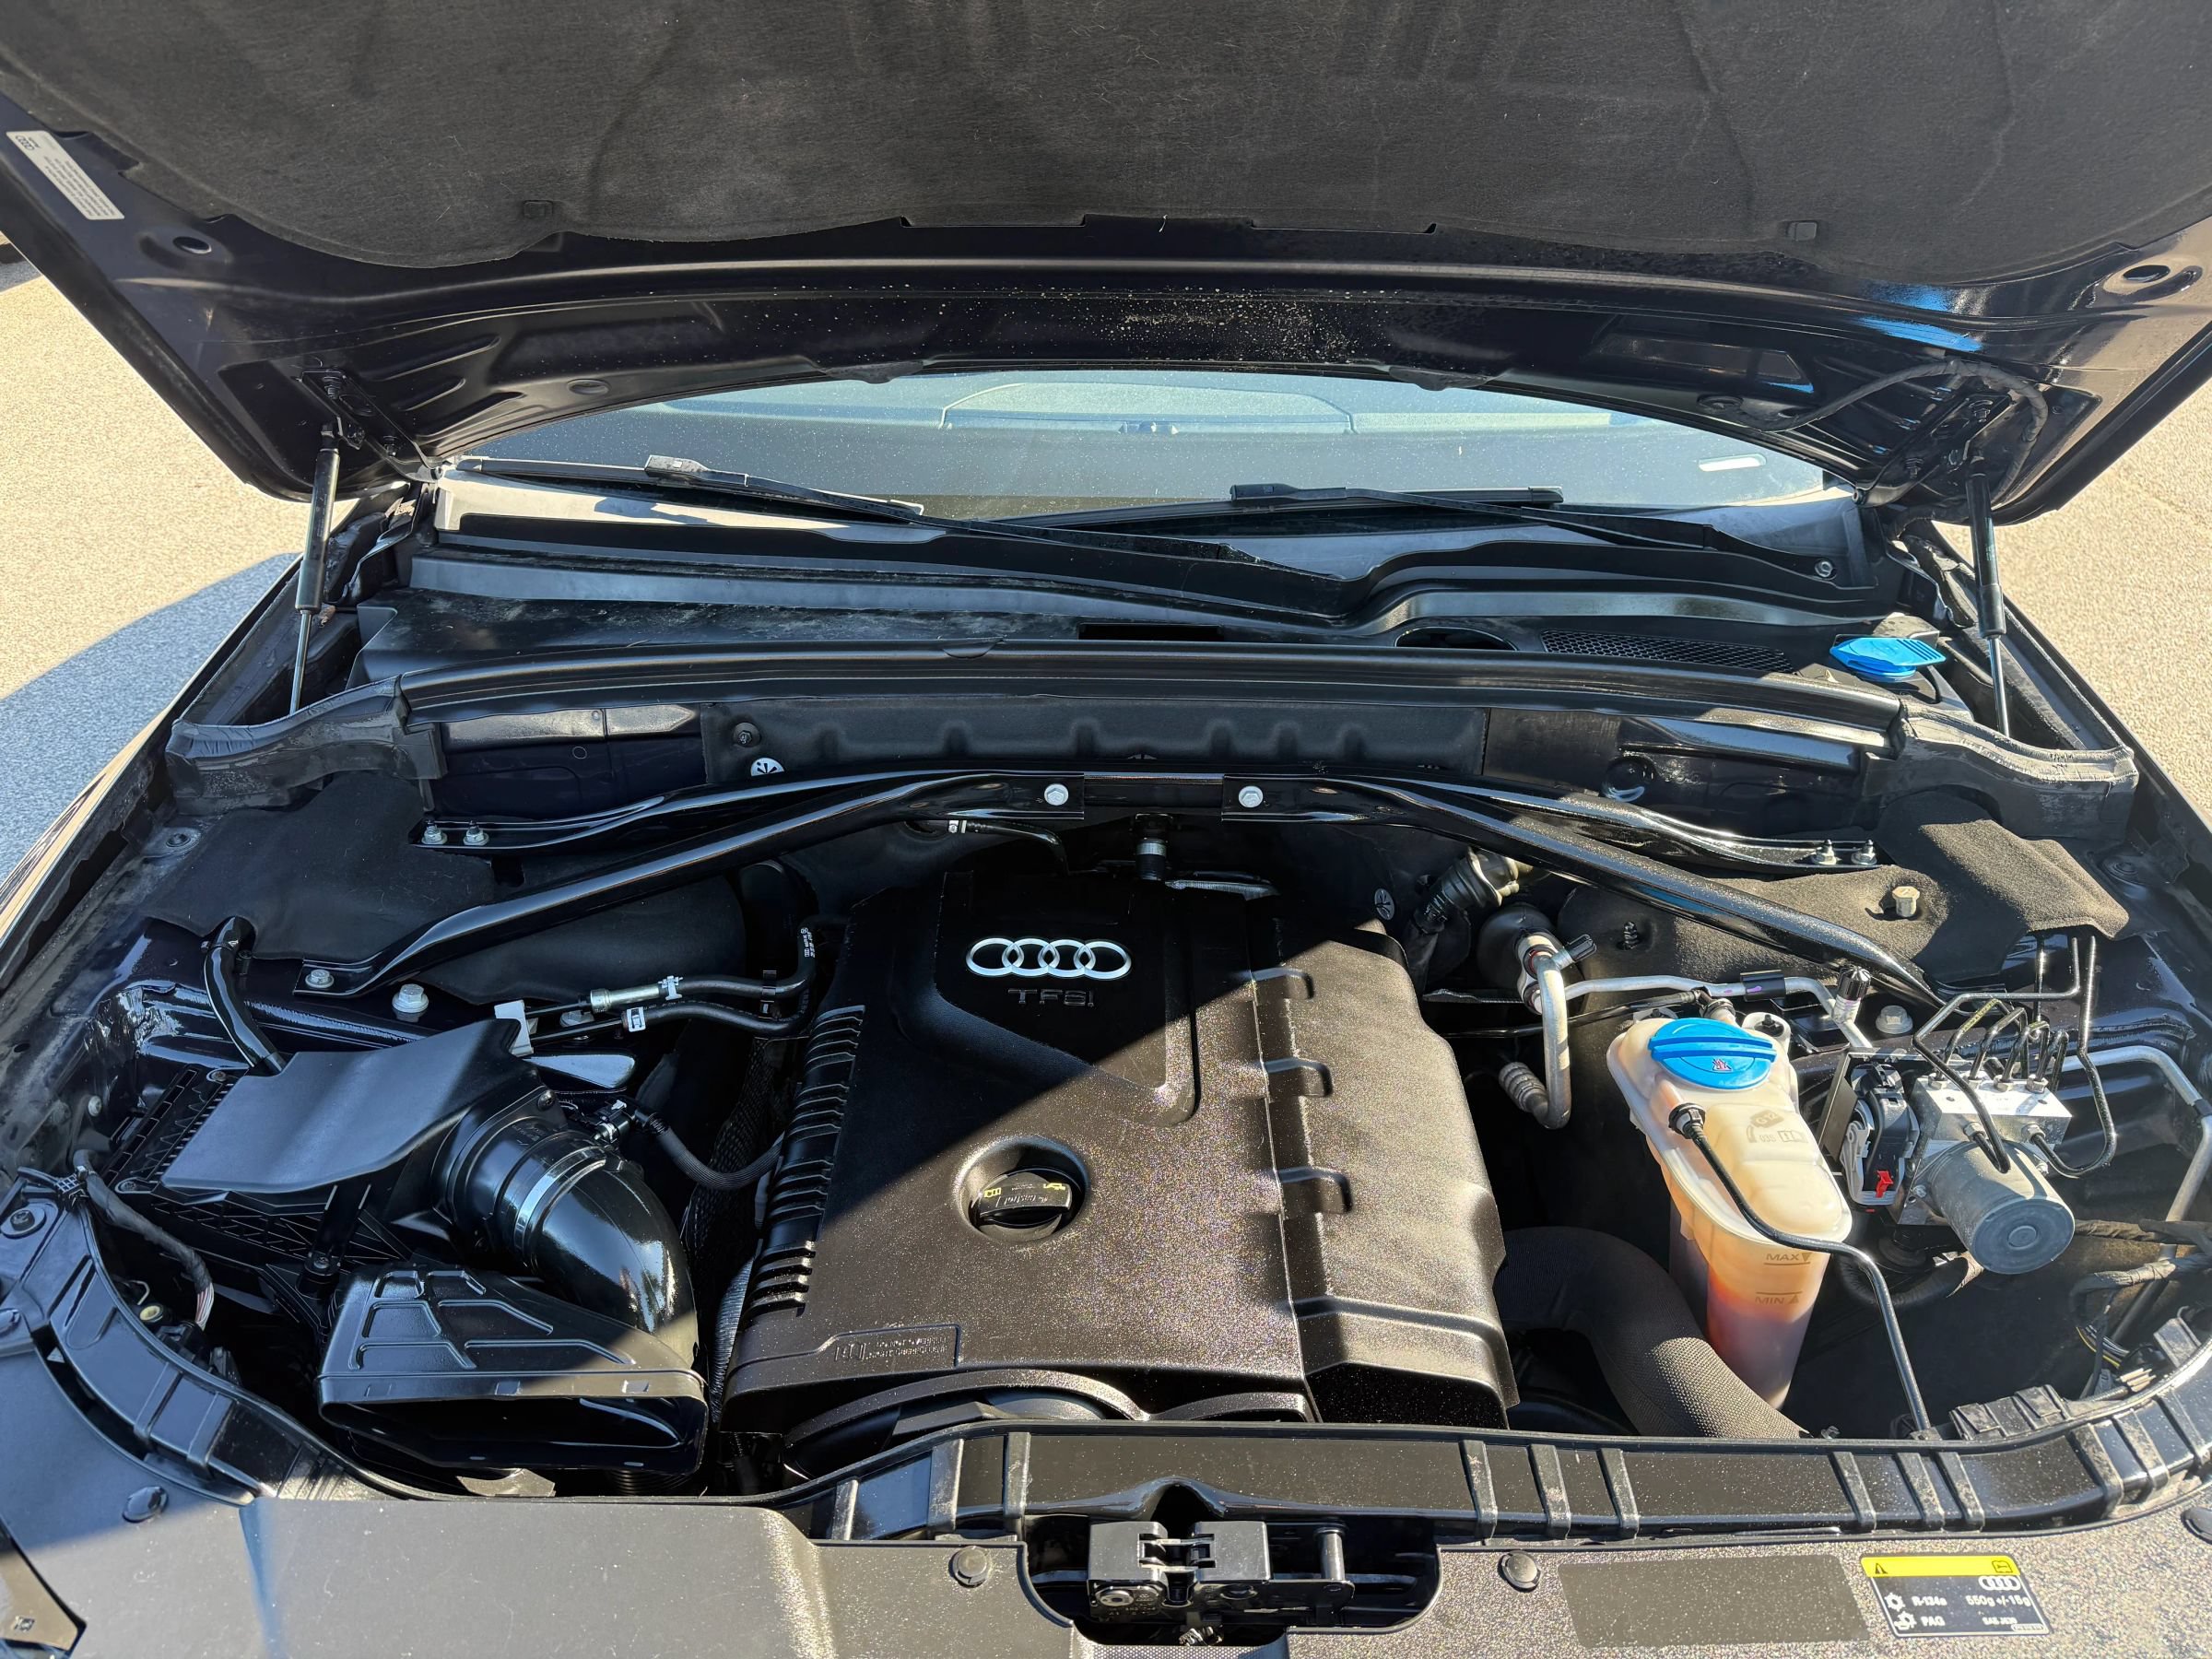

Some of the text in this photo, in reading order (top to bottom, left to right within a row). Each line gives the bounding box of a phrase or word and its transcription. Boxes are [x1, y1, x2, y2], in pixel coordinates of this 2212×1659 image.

[1007, 988, 1095, 1007] TFSI
[1765, 1253, 1800, 1262] MAX
[1754, 1296, 1785, 1305] MIN
[1965, 1594, 1995, 1607] 550g
[1920, 1616, 1946, 1627] PAG
